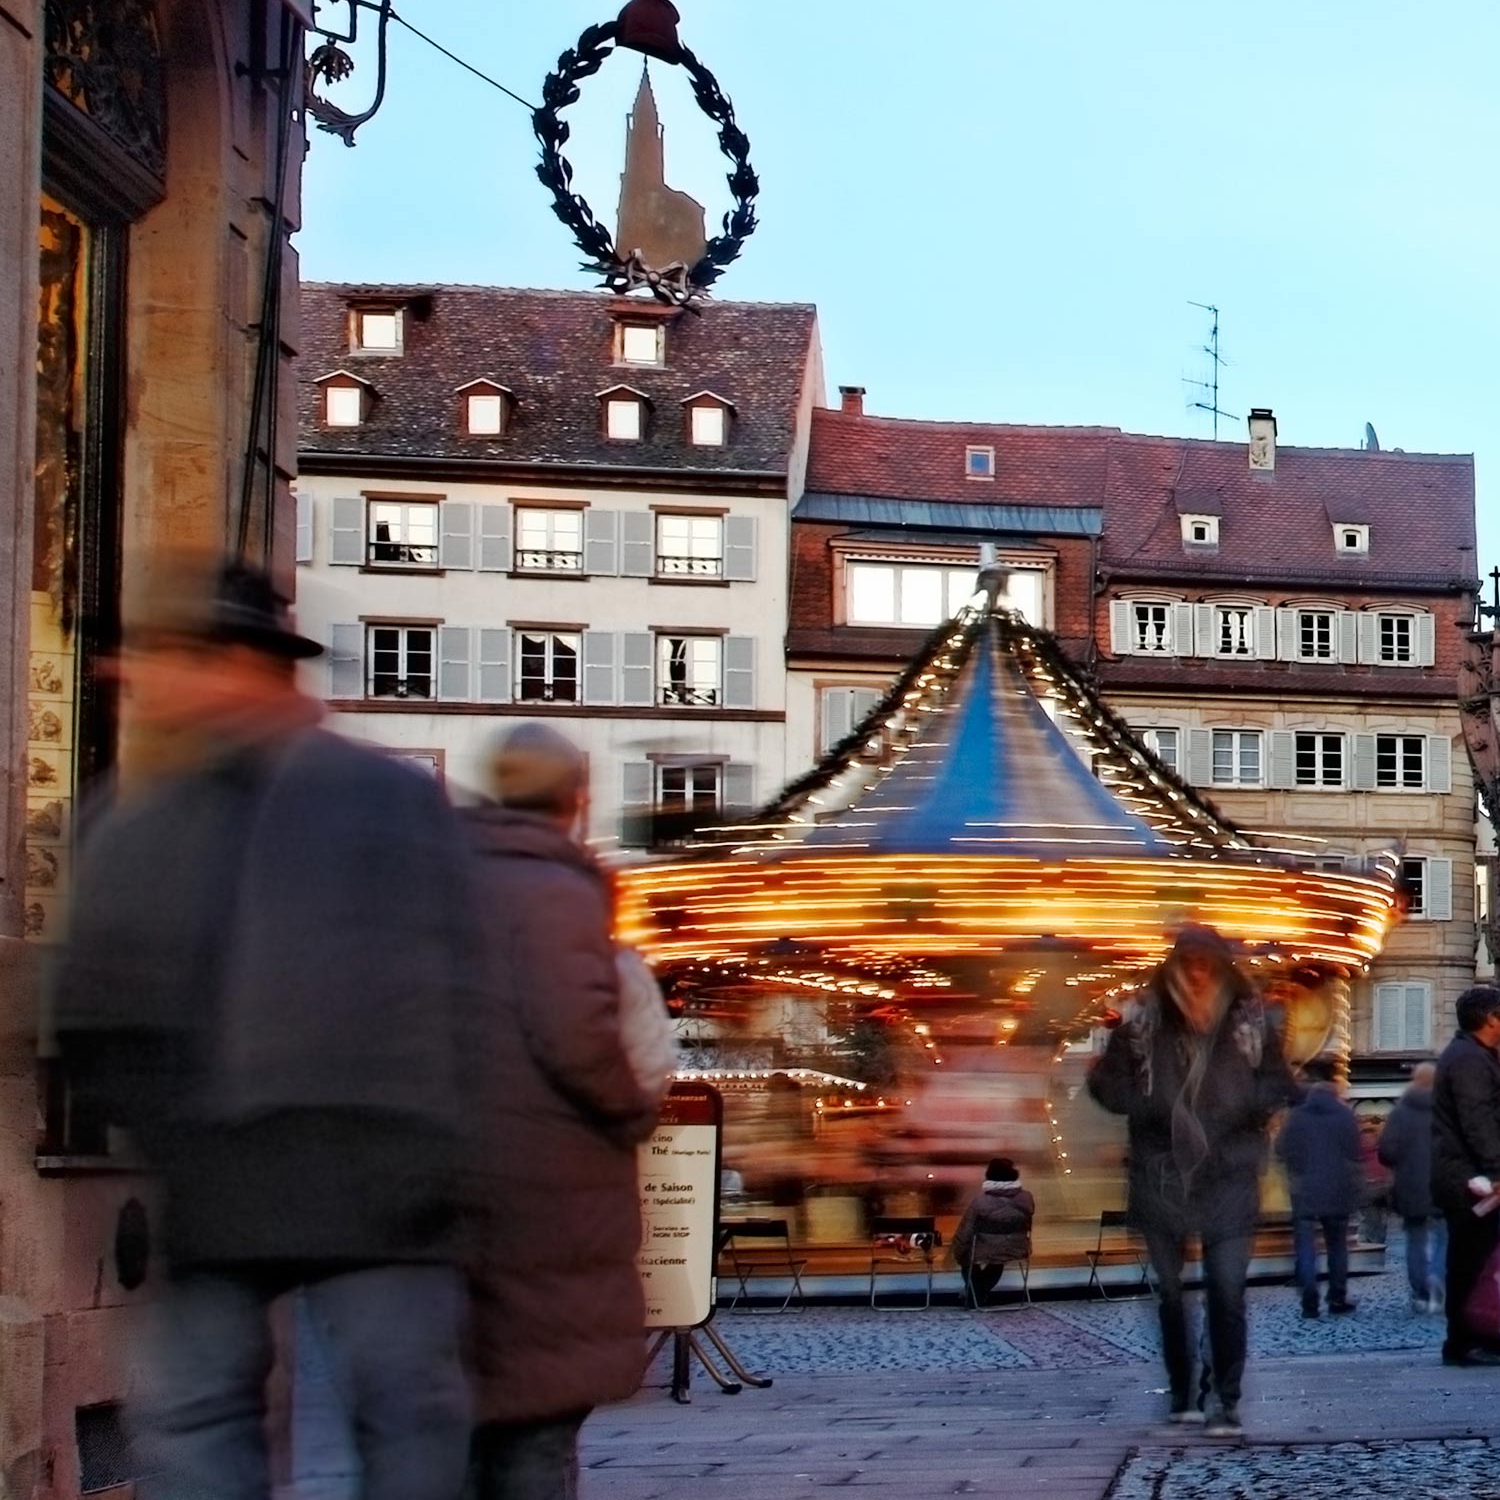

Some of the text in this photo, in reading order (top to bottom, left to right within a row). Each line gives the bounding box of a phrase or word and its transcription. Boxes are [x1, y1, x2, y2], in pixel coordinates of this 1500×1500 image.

[653, 1133, 673, 1143] cino
[652, 1146, 669, 1156] Thé
[644, 1182, 693, 1192] de Saison
[640, 1256, 688, 1266] lsacienne
